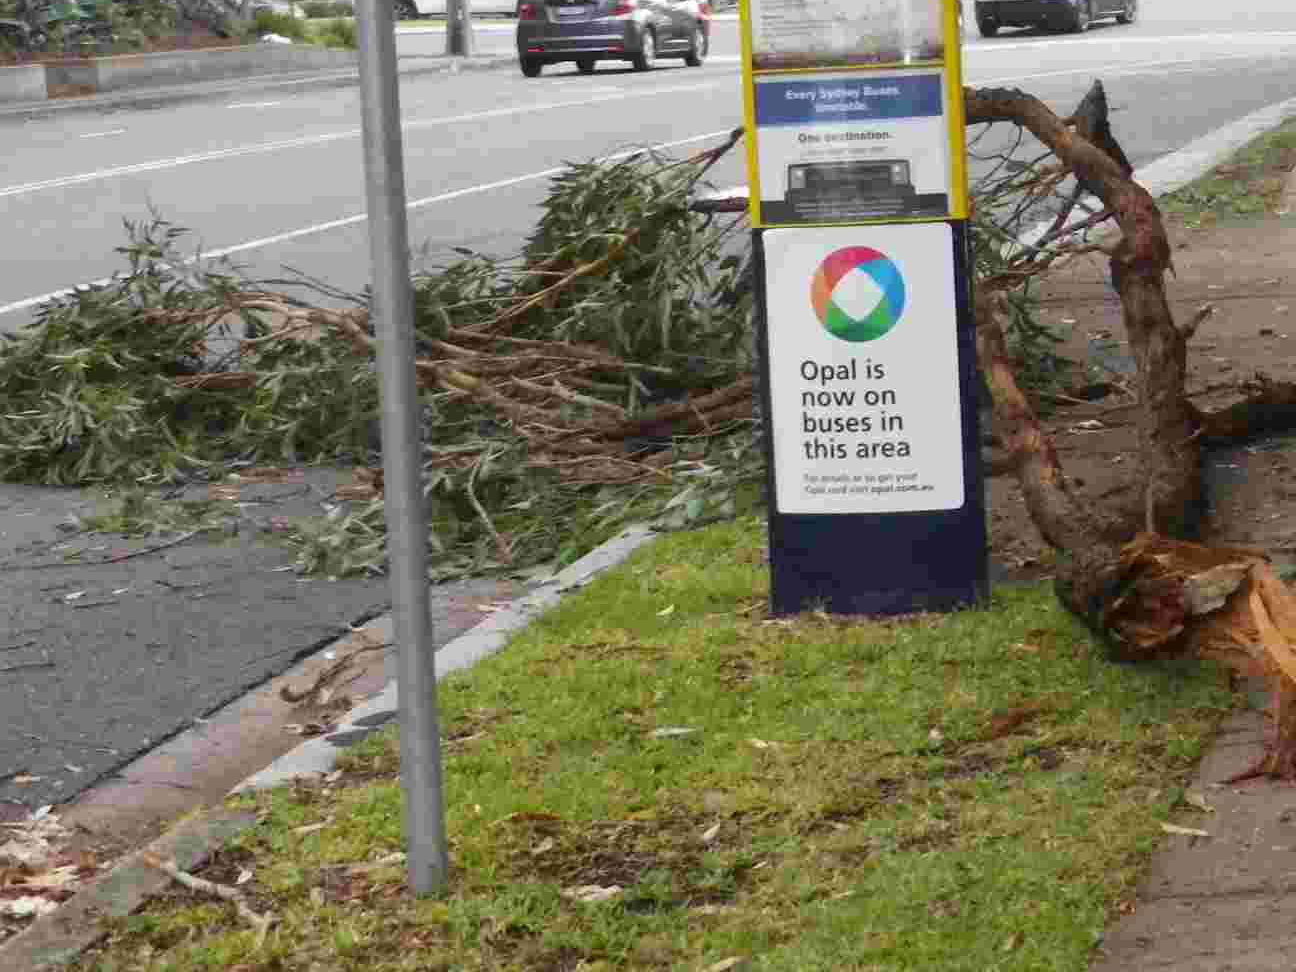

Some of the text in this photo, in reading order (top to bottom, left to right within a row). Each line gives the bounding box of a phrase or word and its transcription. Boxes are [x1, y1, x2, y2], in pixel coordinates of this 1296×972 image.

[800, 358, 885, 386] Opal is
[801, 389, 896, 407] now on
[803, 411, 903, 433] buses in
[804, 437, 911, 459] this area
